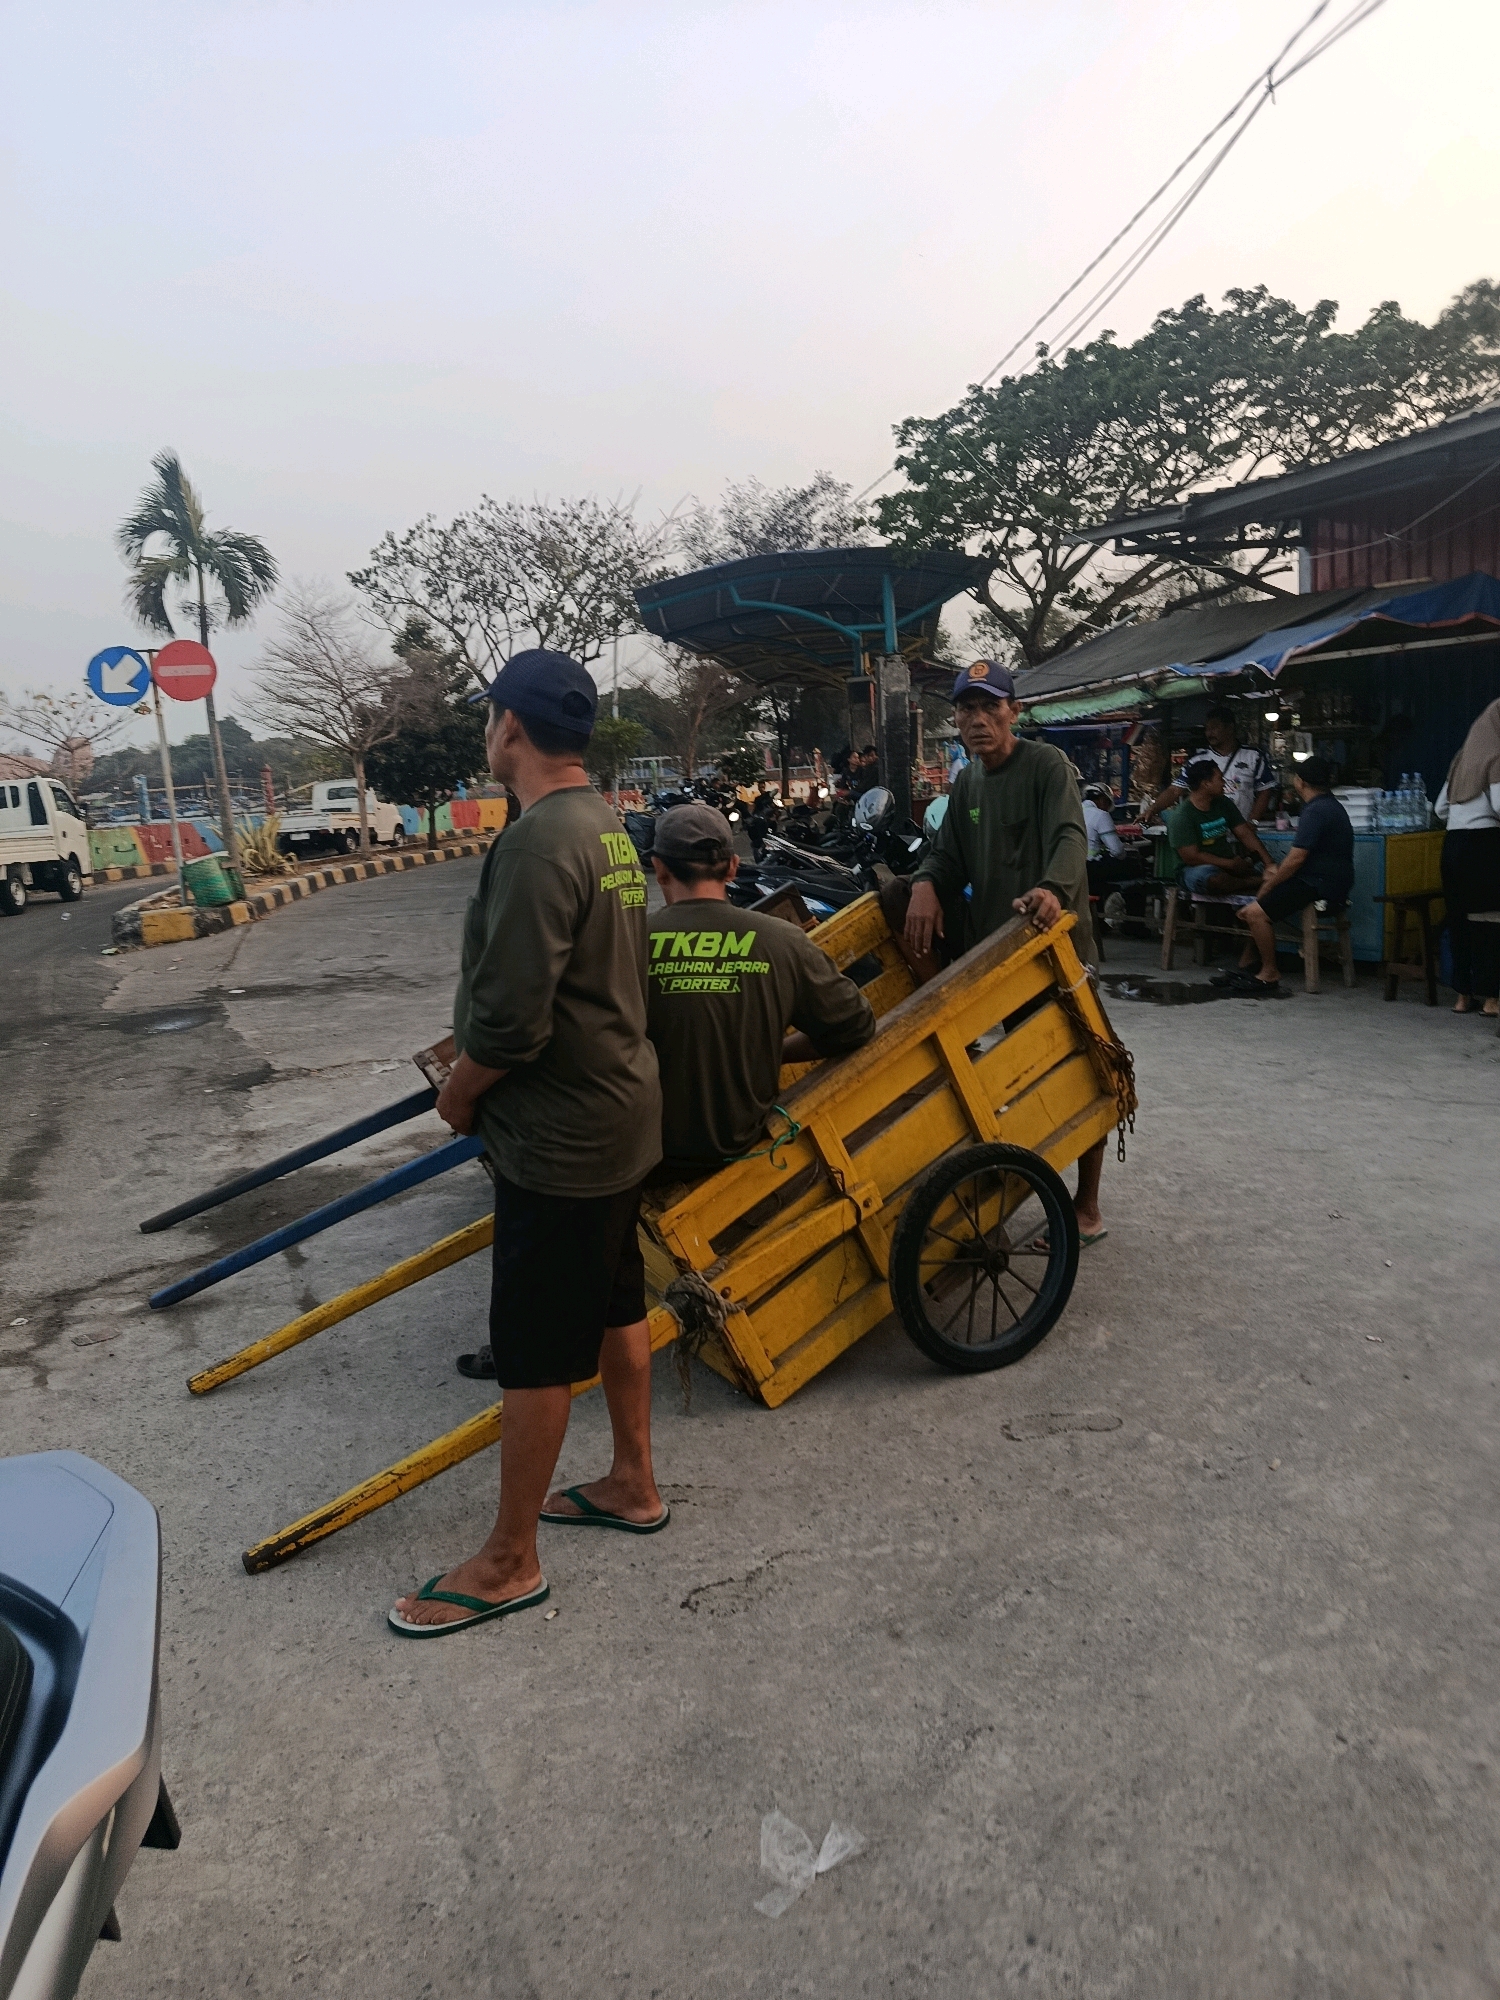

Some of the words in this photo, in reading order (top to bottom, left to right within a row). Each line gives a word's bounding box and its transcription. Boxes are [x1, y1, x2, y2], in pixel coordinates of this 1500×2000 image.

[649, 930, 757, 959] TKBM
[647, 961, 714, 975] LABUHAN
[716, 961, 770, 974] JEPARA
[669, 978, 731, 991] PORTER
